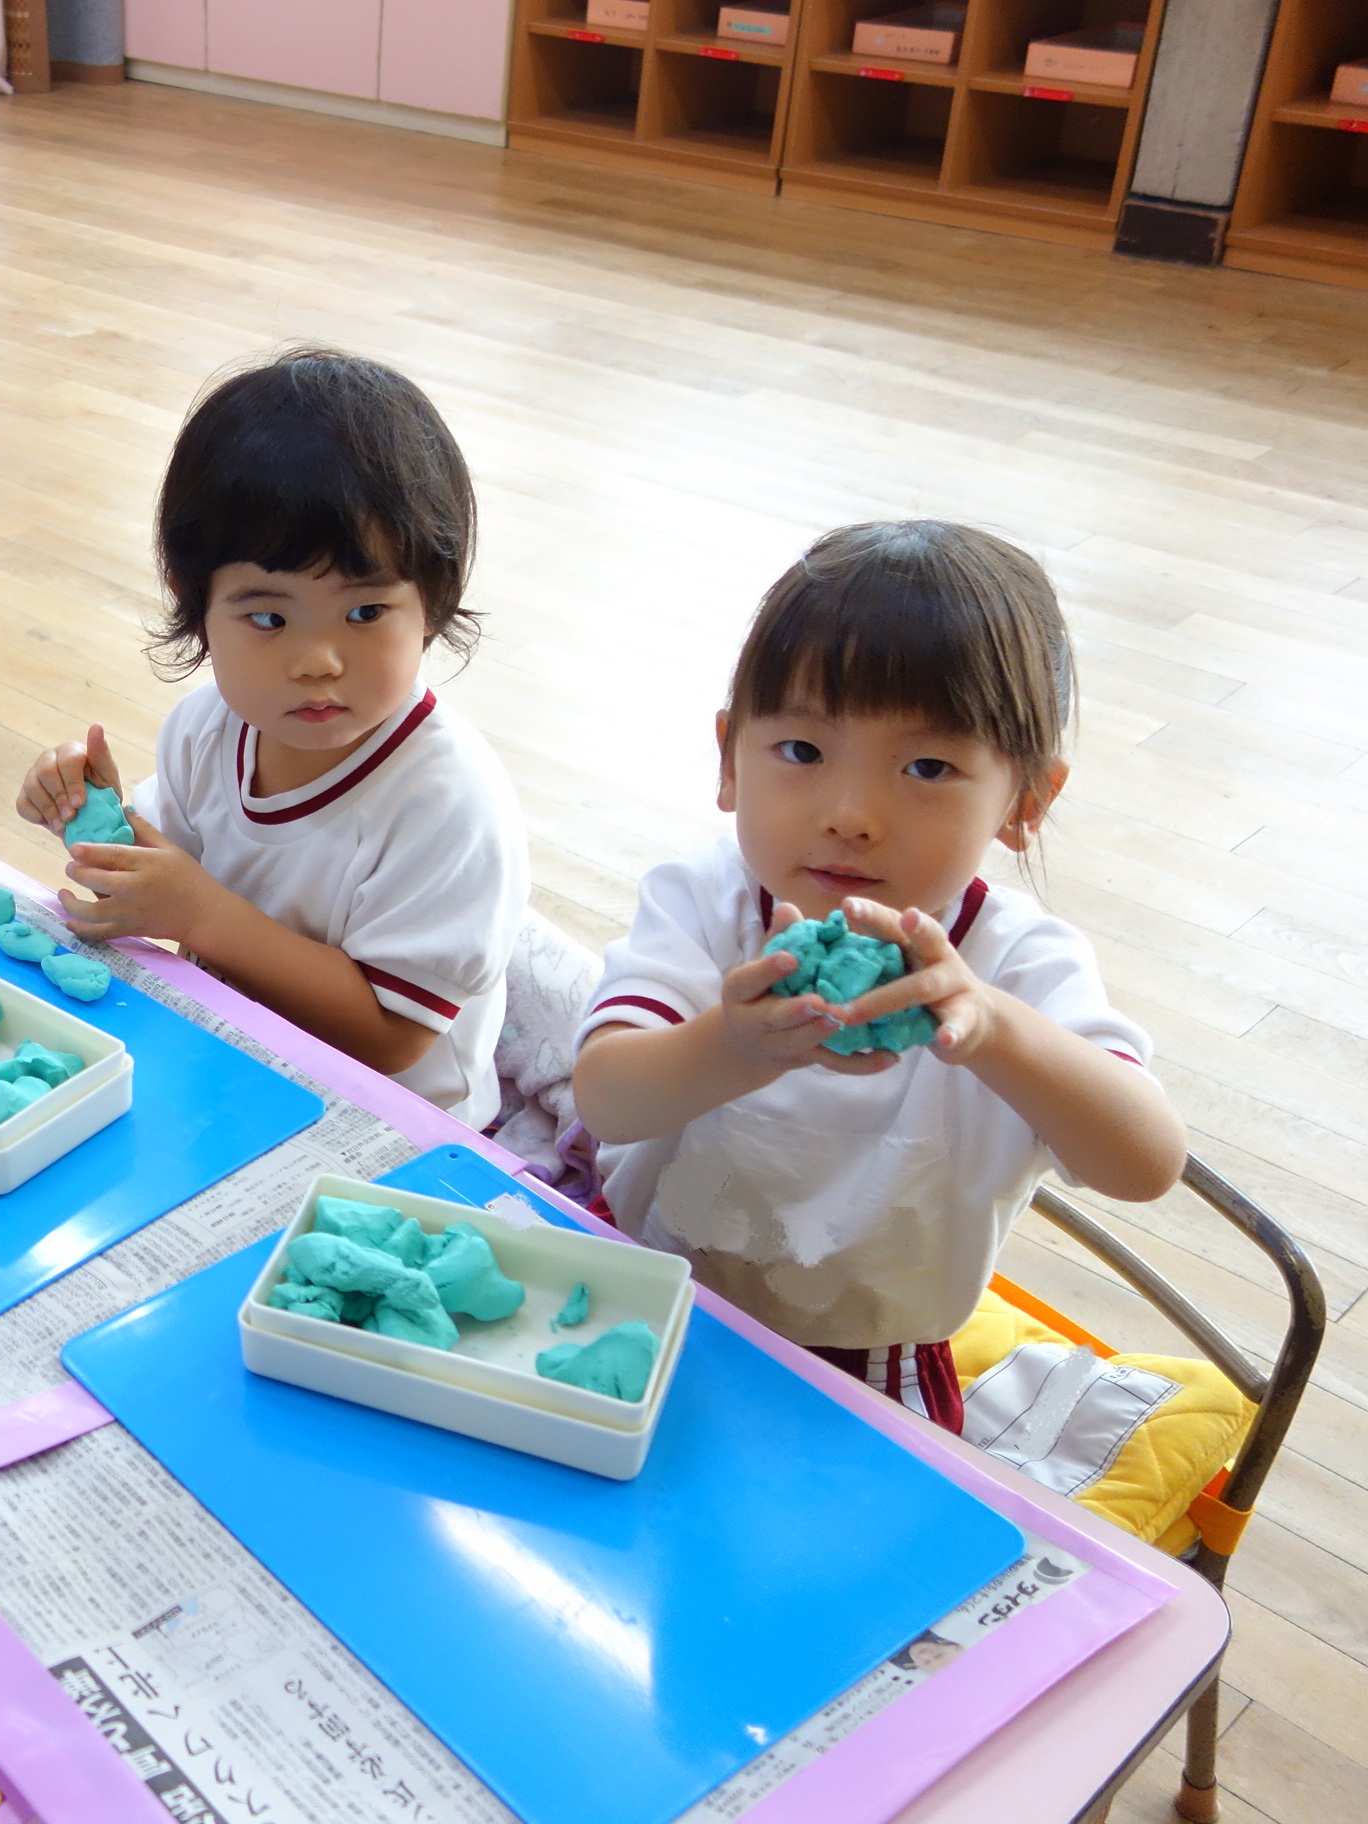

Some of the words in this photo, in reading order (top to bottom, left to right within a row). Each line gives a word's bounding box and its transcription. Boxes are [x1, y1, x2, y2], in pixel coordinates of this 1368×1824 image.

[93, 1640, 269, 1819] スクワへ北上
